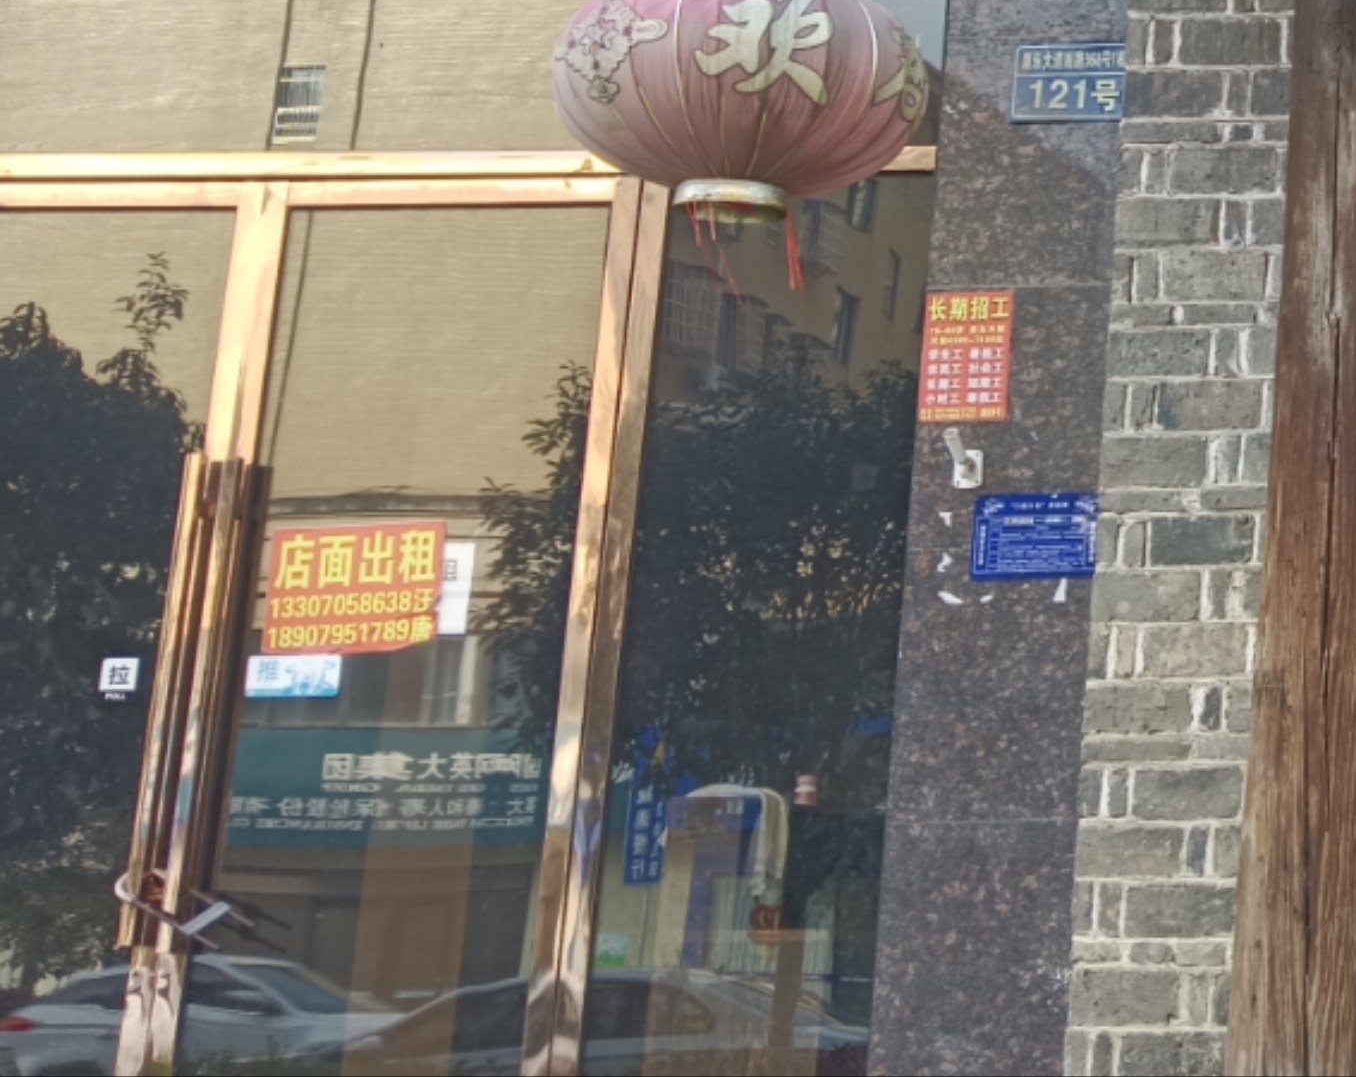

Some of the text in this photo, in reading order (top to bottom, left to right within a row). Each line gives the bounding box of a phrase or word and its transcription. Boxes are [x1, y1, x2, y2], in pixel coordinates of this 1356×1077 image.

[1029, 79, 1120, 112] 121号
[928, 296, 1010, 321] 长期招工
[274, 529, 437, 589] 店面出租
[107, 664, 131, 685] 拉
